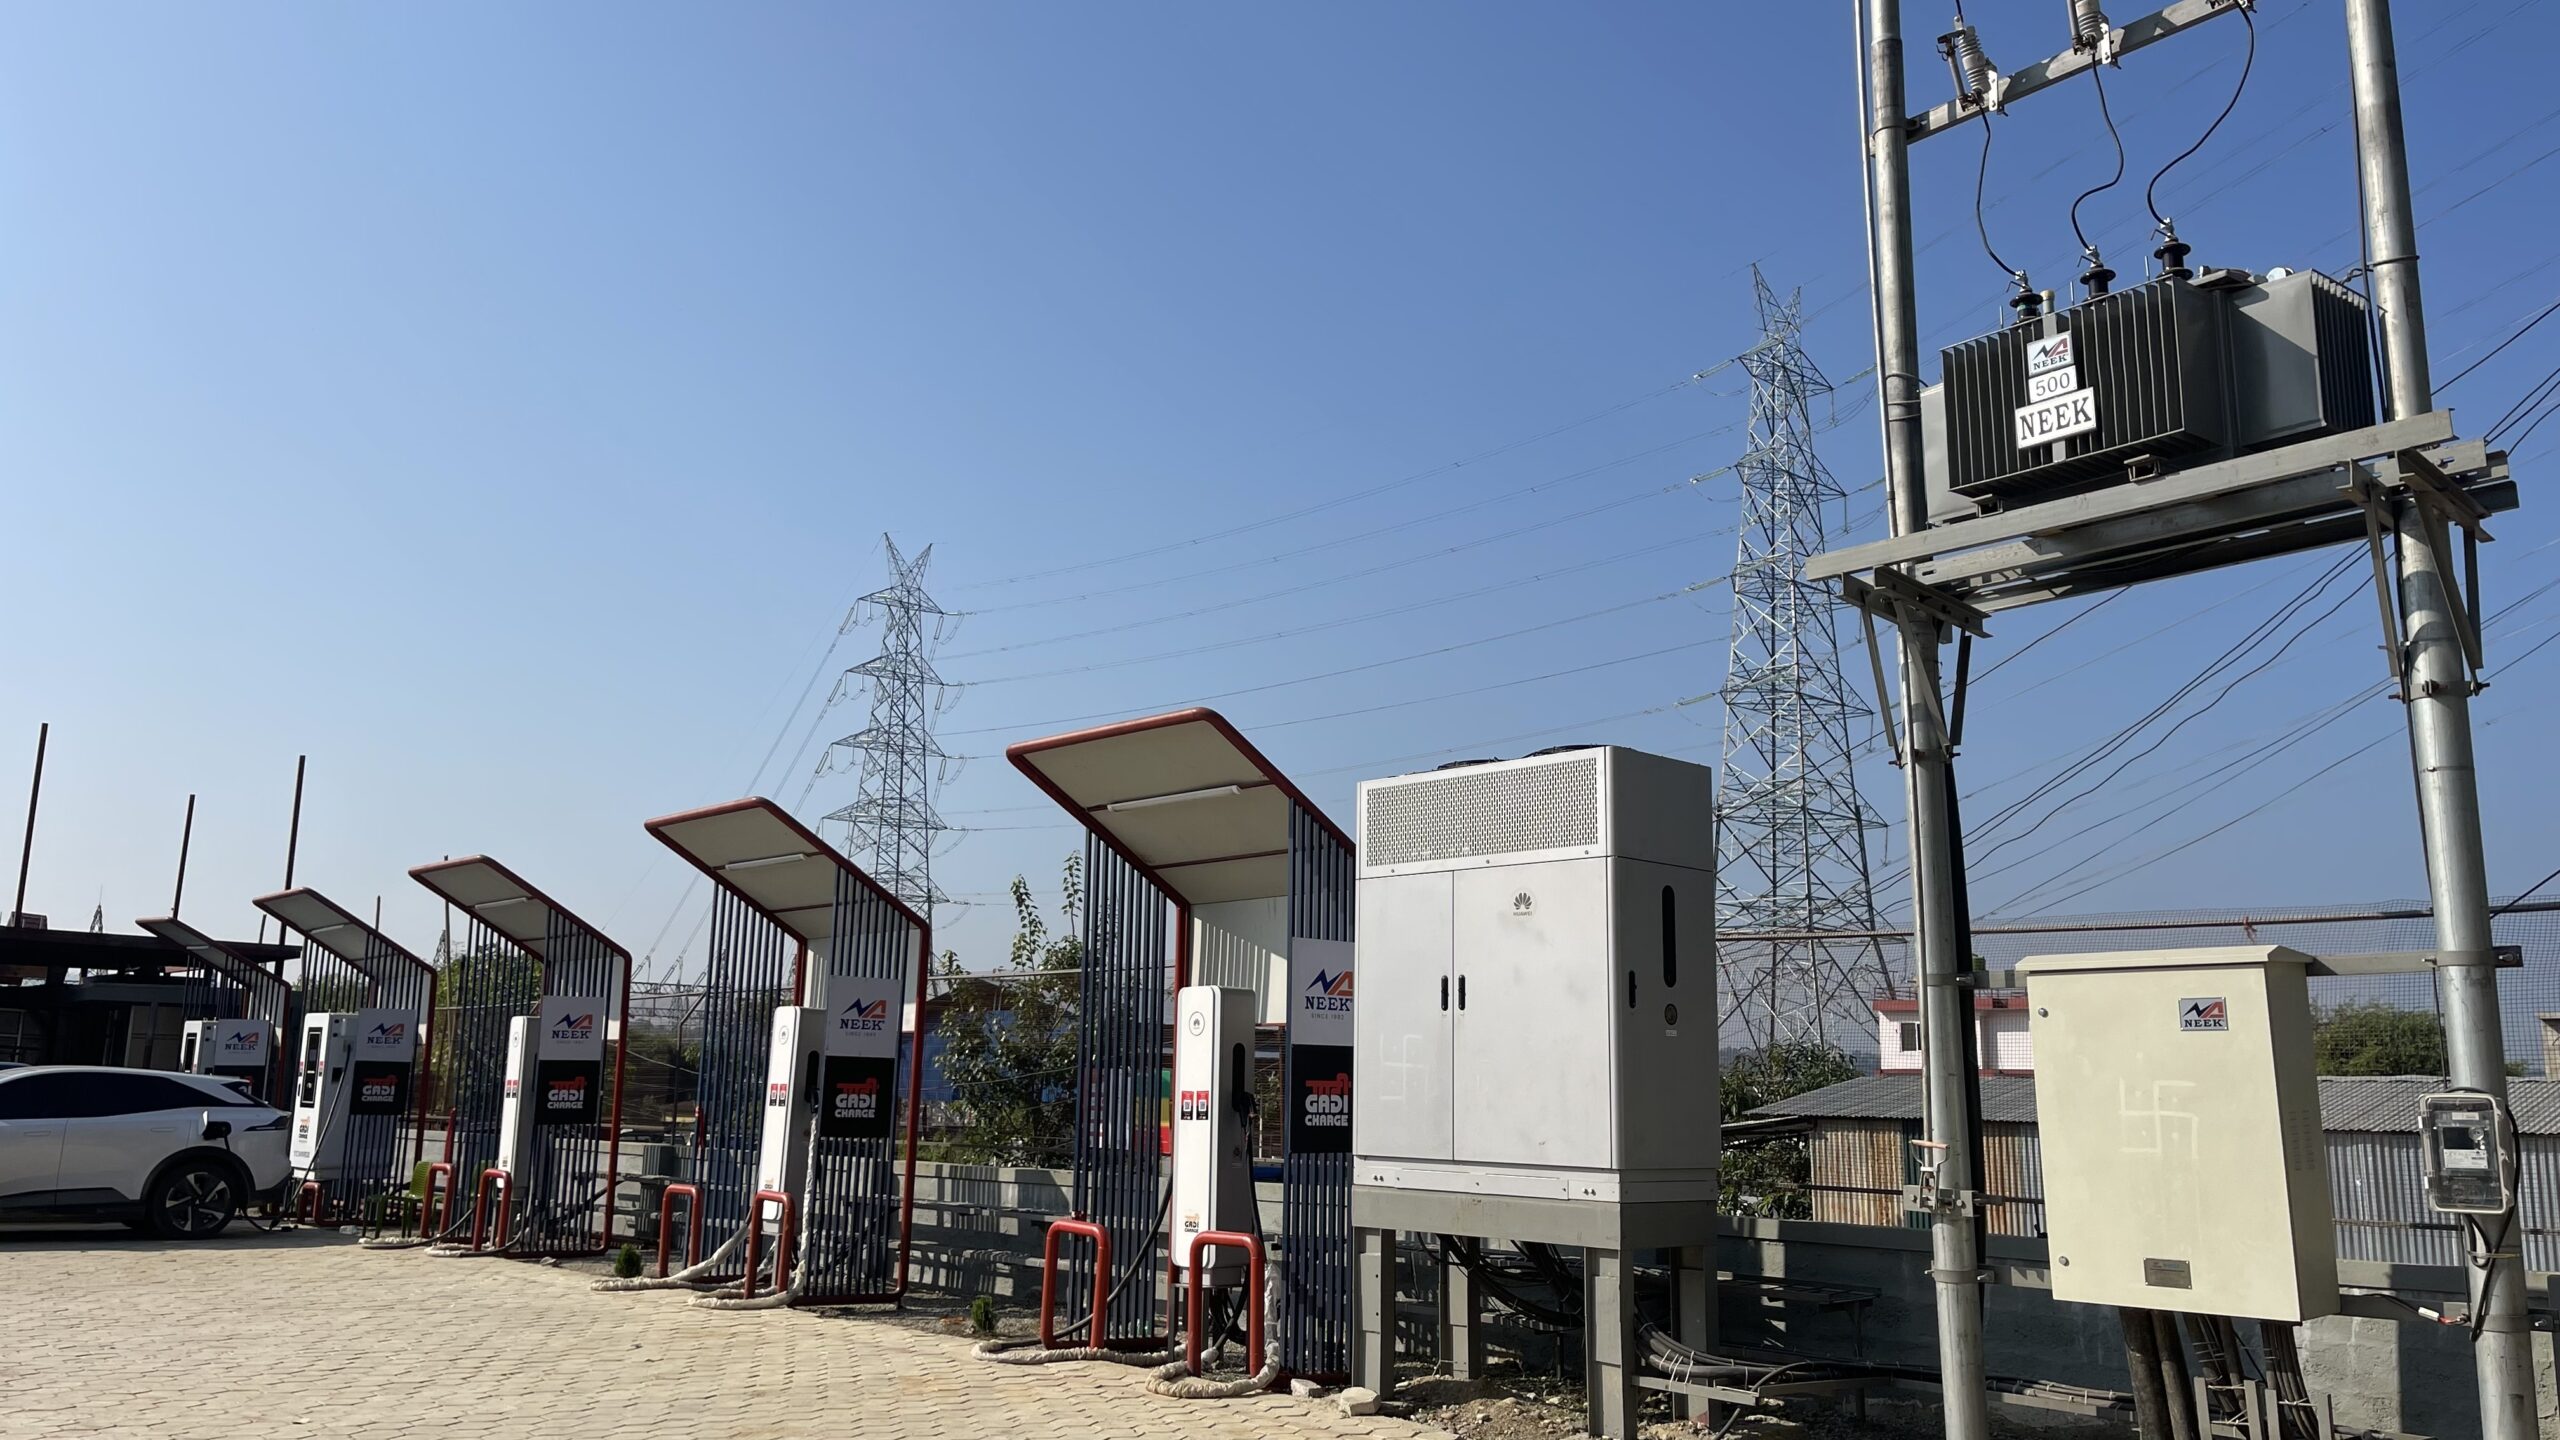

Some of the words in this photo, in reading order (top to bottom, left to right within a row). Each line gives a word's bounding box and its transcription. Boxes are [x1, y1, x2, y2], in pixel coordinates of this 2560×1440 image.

[2033, 354, 2067, 370] NEEK
[2035, 372, 2070, 397] 500
[2019, 396, 2092, 440] NEEK
[1305, 996, 1351, 1011] NEEK
[840, 1019, 884, 1030] NEEK
[2184, 1019, 2223, 1028] NEEK
[367, 1036, 402, 1045] NEEK
[552, 1030, 590, 1039] NEEK
[362, 1085, 396, 1096] GADI
[548, 1089, 585, 1101] GADI
[835, 1094, 876, 1108] GADI
[1305, 1094, 1349, 1113] GADI
[834, 1109, 876, 1118] CHARGE
[1305, 1114, 1349, 1126] CHARGE
